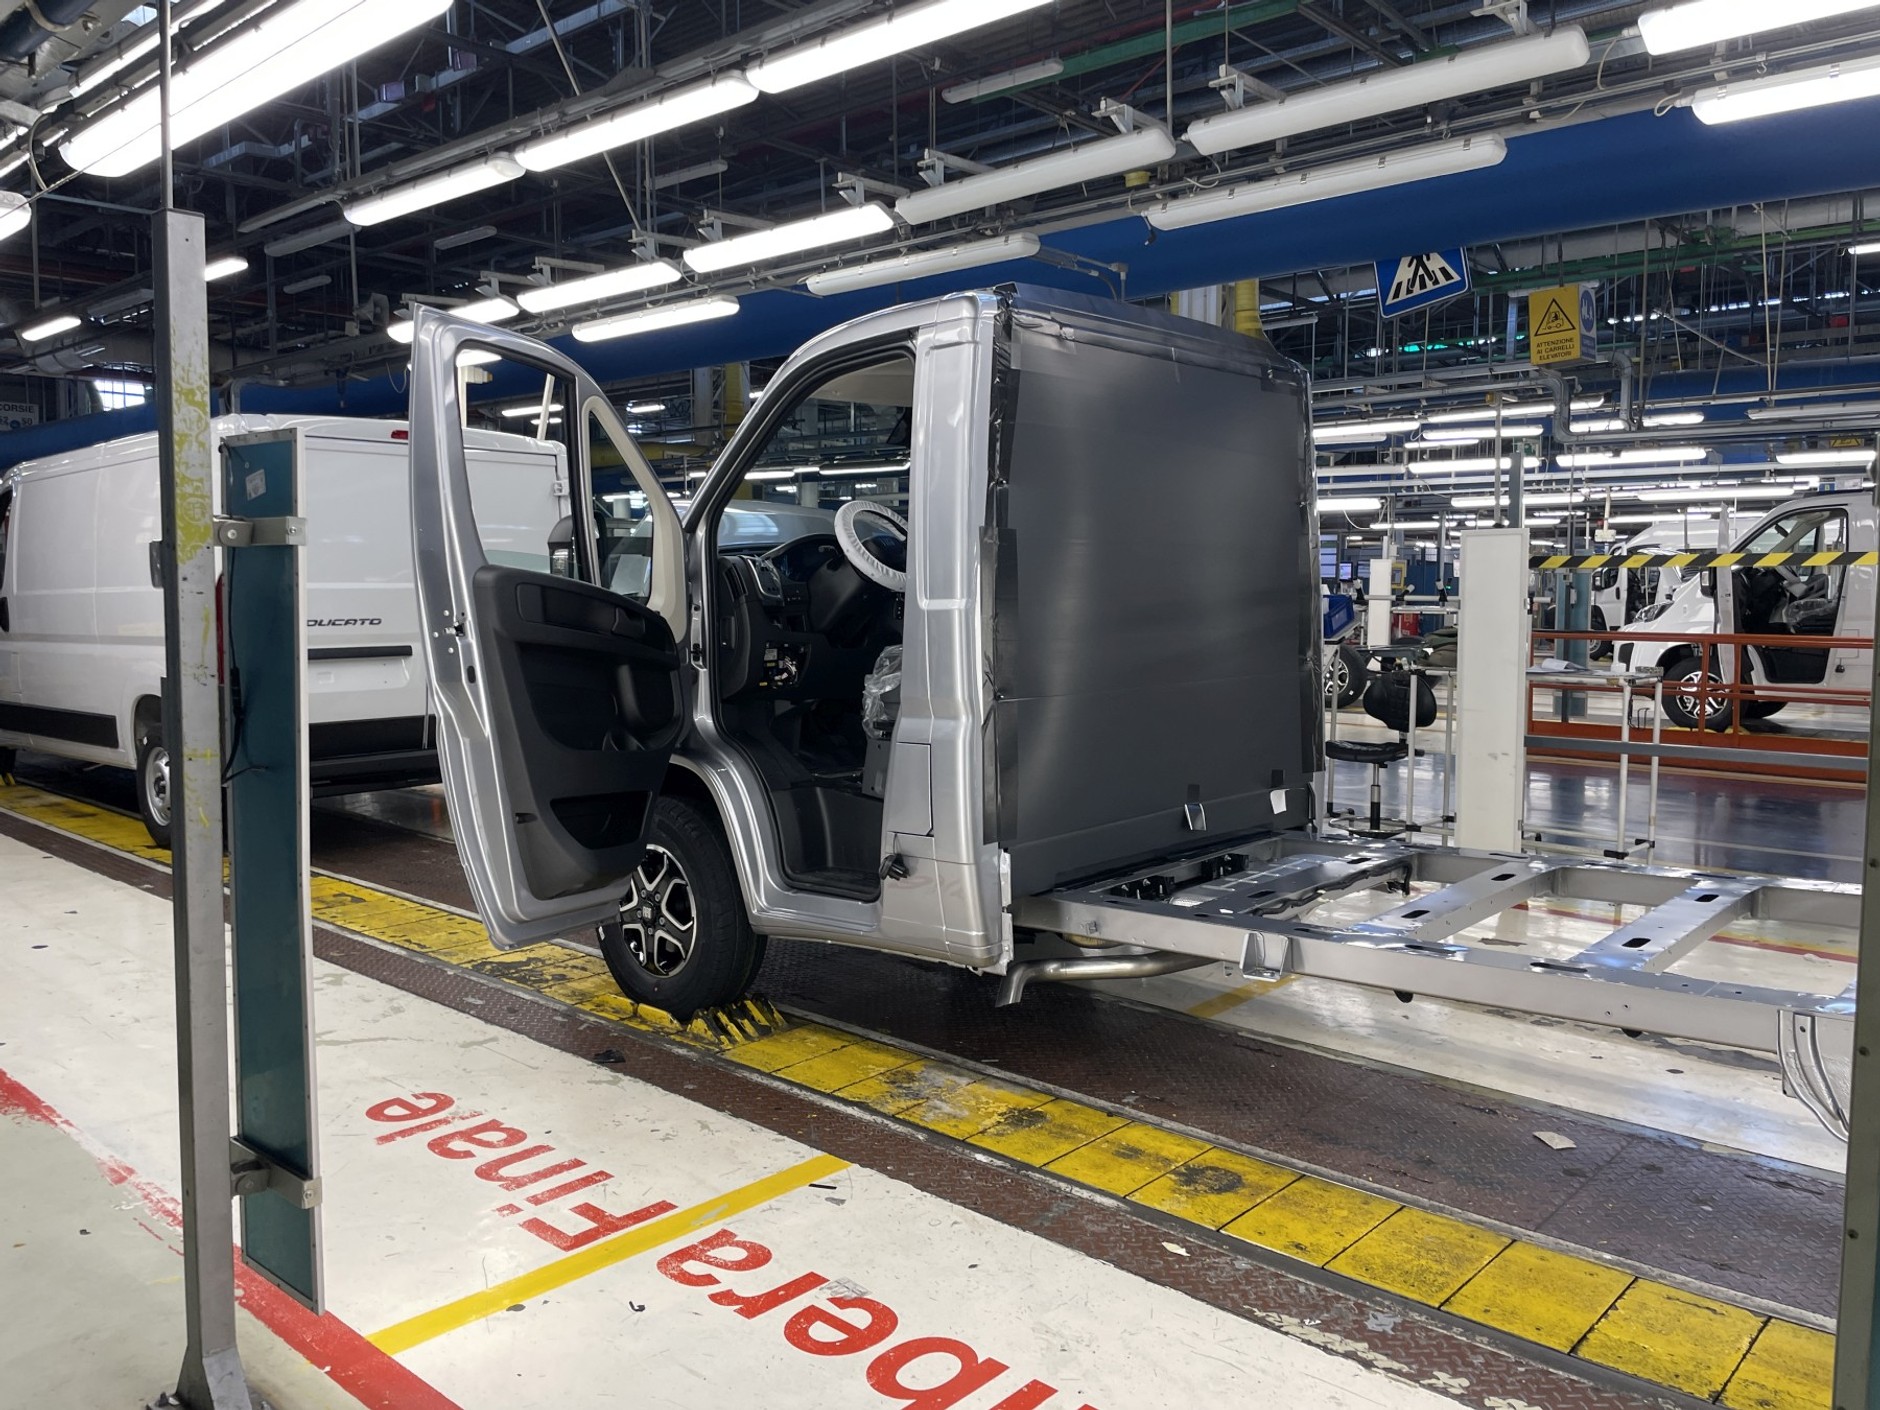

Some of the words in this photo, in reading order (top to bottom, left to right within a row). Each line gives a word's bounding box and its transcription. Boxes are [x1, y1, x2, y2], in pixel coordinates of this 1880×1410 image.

[1536, 337, 1574, 348] ATTENZIONE
[1544, 343, 1575, 354] CARRELLI
[1539, 350, 1572, 361] ELEVATORI
[306, 618, 382, 627] DUCATO
[365, 1092, 677, 1252] Finale
